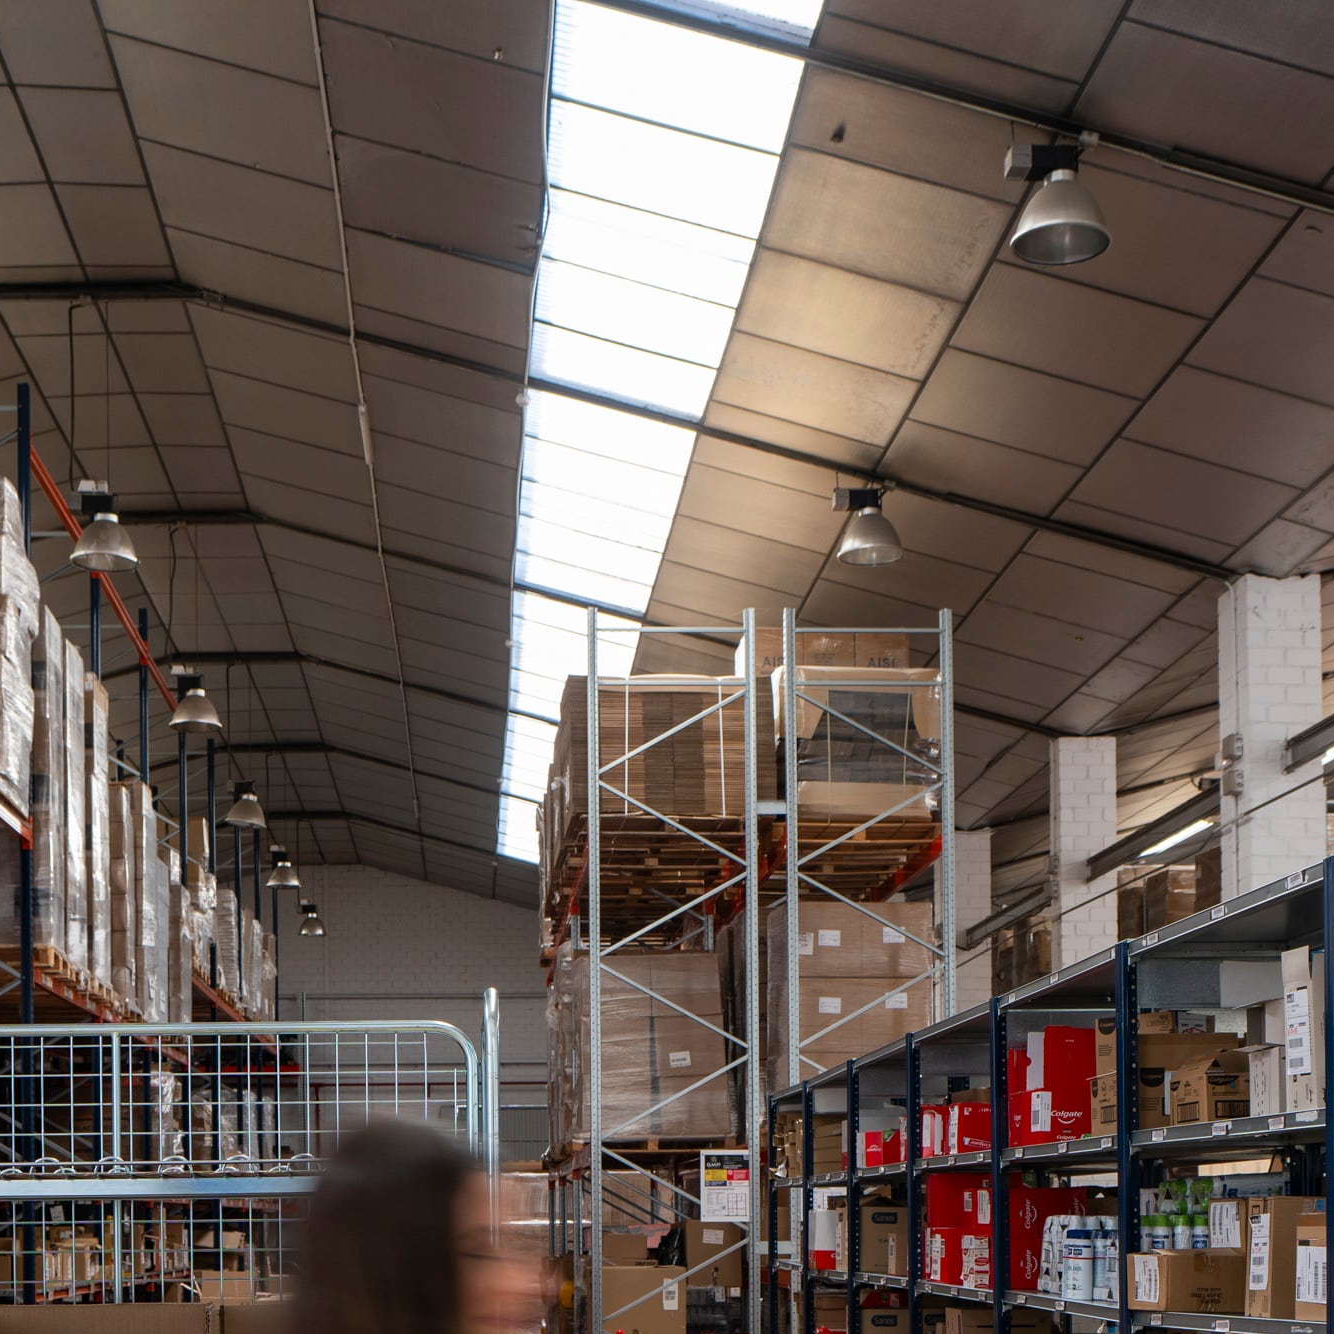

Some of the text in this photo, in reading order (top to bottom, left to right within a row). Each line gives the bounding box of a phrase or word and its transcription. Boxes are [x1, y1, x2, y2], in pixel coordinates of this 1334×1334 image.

[1050, 1110, 1083, 1118] Colgate
[1024, 1199, 1032, 1230] Colgate
[1024, 1249, 1032, 1280] Colgate
